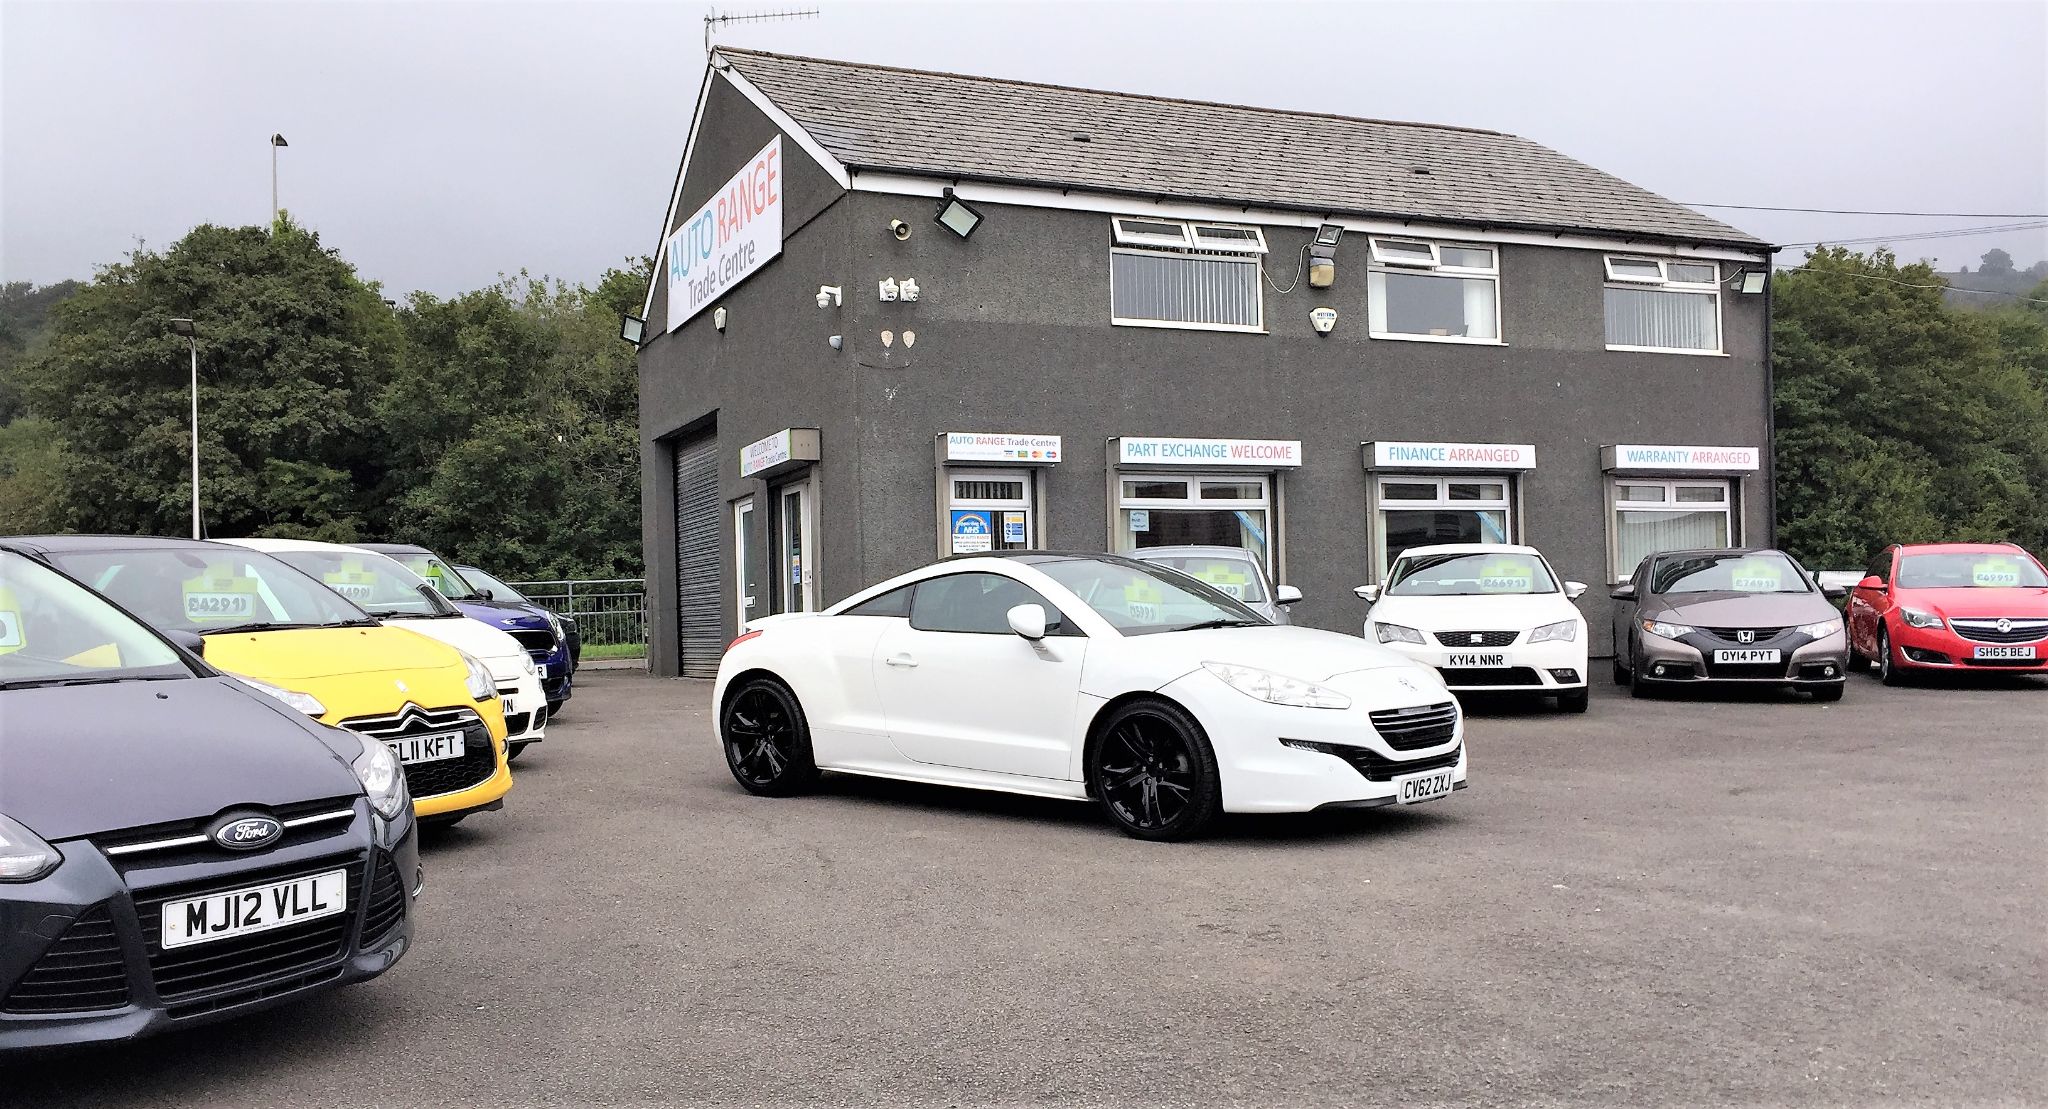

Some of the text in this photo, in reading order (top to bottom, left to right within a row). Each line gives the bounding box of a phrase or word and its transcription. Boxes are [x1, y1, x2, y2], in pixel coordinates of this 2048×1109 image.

[671, 147, 778, 288] AUTO RANGE
[688, 239, 756, 310] Trade Centre
[950, 436, 1057, 447] AUTO RANGE Trade Centre
[1127, 443, 1292, 459] PART EXCHANGE WELCOME
[1389, 446, 1520, 462] FINANCE ARRANGED
[1627, 450, 1751, 464] WARRANTY ARRANGED
[963, 526, 980, 534] NHS
[1449, 654, 1504, 666] KY14 NNR
[1721, 650, 1773, 661] OY14 PYT
[1978, 647, 2031, 657] SH65 BEJ
[424, 735, 456, 758] KFT
[1404, 773, 1452, 800] CV62 ZXJ
[234, 821, 269, 841] Ford
[186, 879, 328, 937] MJ12 VLL
